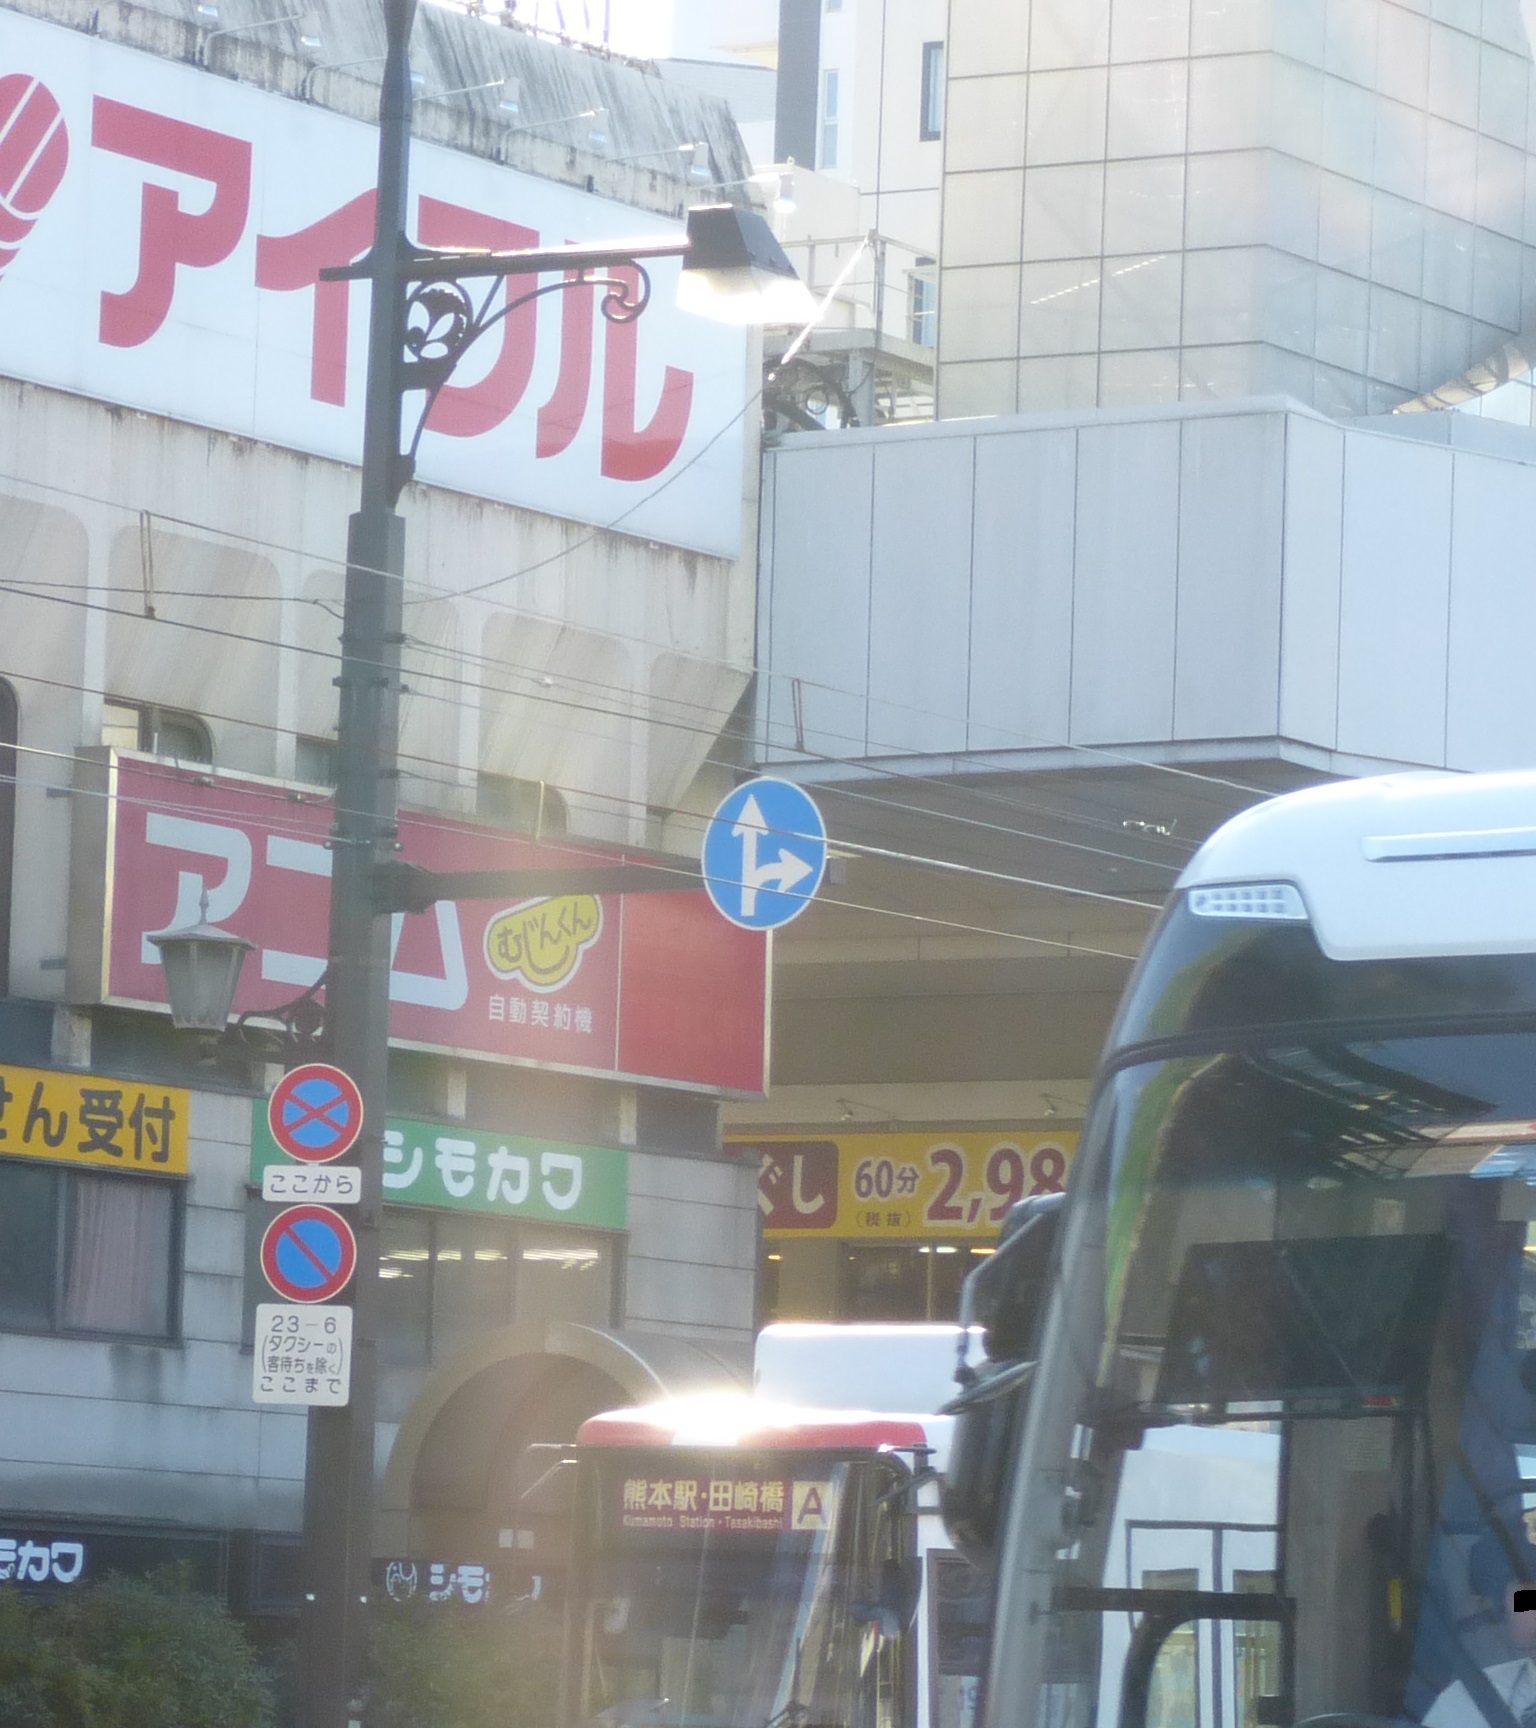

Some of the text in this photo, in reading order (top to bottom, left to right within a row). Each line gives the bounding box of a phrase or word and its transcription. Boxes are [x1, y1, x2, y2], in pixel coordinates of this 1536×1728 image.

[91, 94, 695, 484] アイフル
[497, 901, 592, 975] むじんくん
[488, 993, 594, 1035] 自動契約機
[0, 1083, 176, 1163] ん受付
[269, 1174, 354, 1195] ここから
[382, 1131, 583, 1211] シモカワ
[854, 1159, 920, 1200] 60分
[260, 1376, 342, 1394] ここまで
[623, 1479, 785, 1513] 熊本駅・田崎橋
[796, 1486, 827, 1526] A
[623, 1515, 673, 1528] Kumamoto
